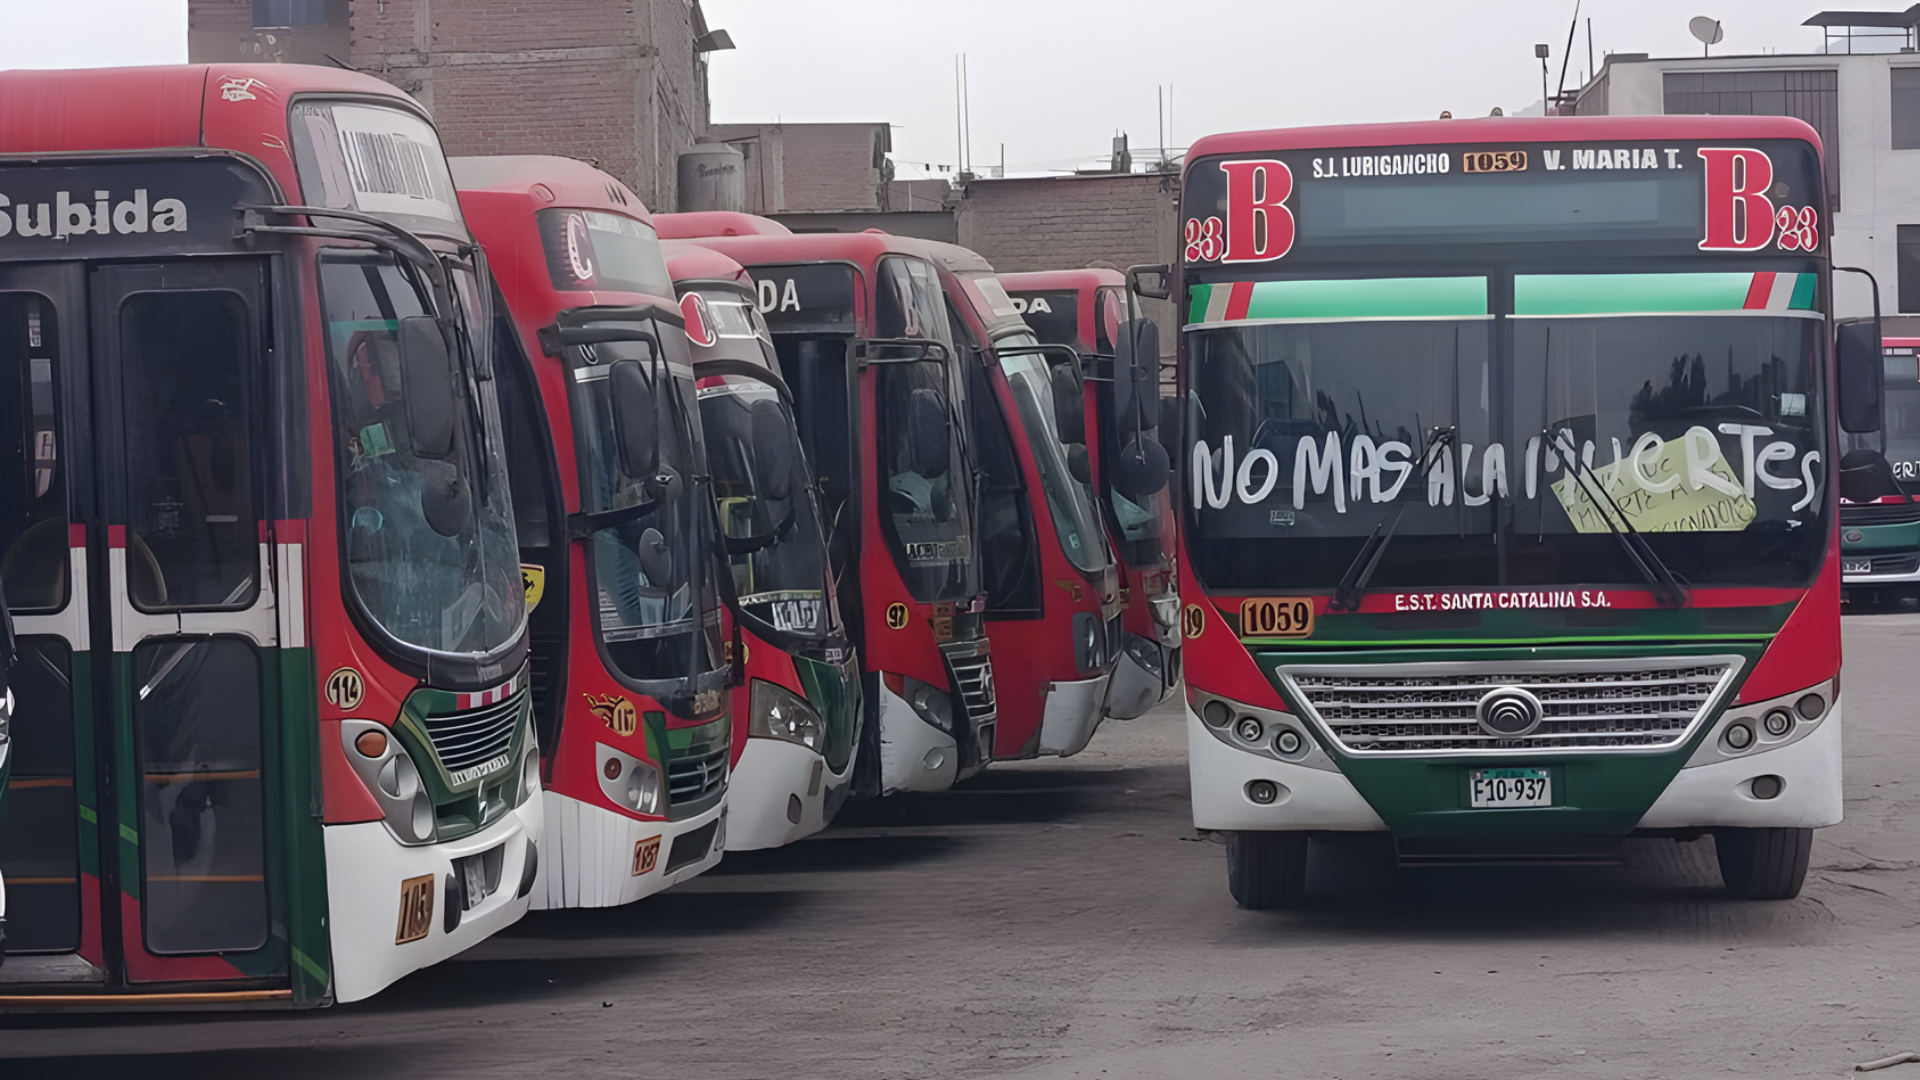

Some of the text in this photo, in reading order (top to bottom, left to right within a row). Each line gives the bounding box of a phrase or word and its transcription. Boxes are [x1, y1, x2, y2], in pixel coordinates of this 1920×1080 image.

[1342, 153, 1450, 177] LURIGANCHO
[1465, 153, 1526, 171] 1059
[1543, 148, 1683, 170] V. MARIA T.
[1220, 159, 1295, 264] B
[1697, 147, 1776, 251] B
[1185, 216, 1224, 262] 23
[1776, 205, 1819, 252] 23
[758, 279, 800, 313] DA
[1009, 297, 1052, 314] DA
[1193, 435, 1278, 509] NO
[1293, 431, 1413, 513] MAS
[1427, 442, 1455, 506] A
[1461, 443, 1509, 506] LA
[1395, 590, 1611, 611] E.S.T. SANTA CATALINA S.A.
[889, 605, 906, 628] 97
[1248, 601, 1309, 632] 1059
[1473, 777, 1547, 802] F10-937
